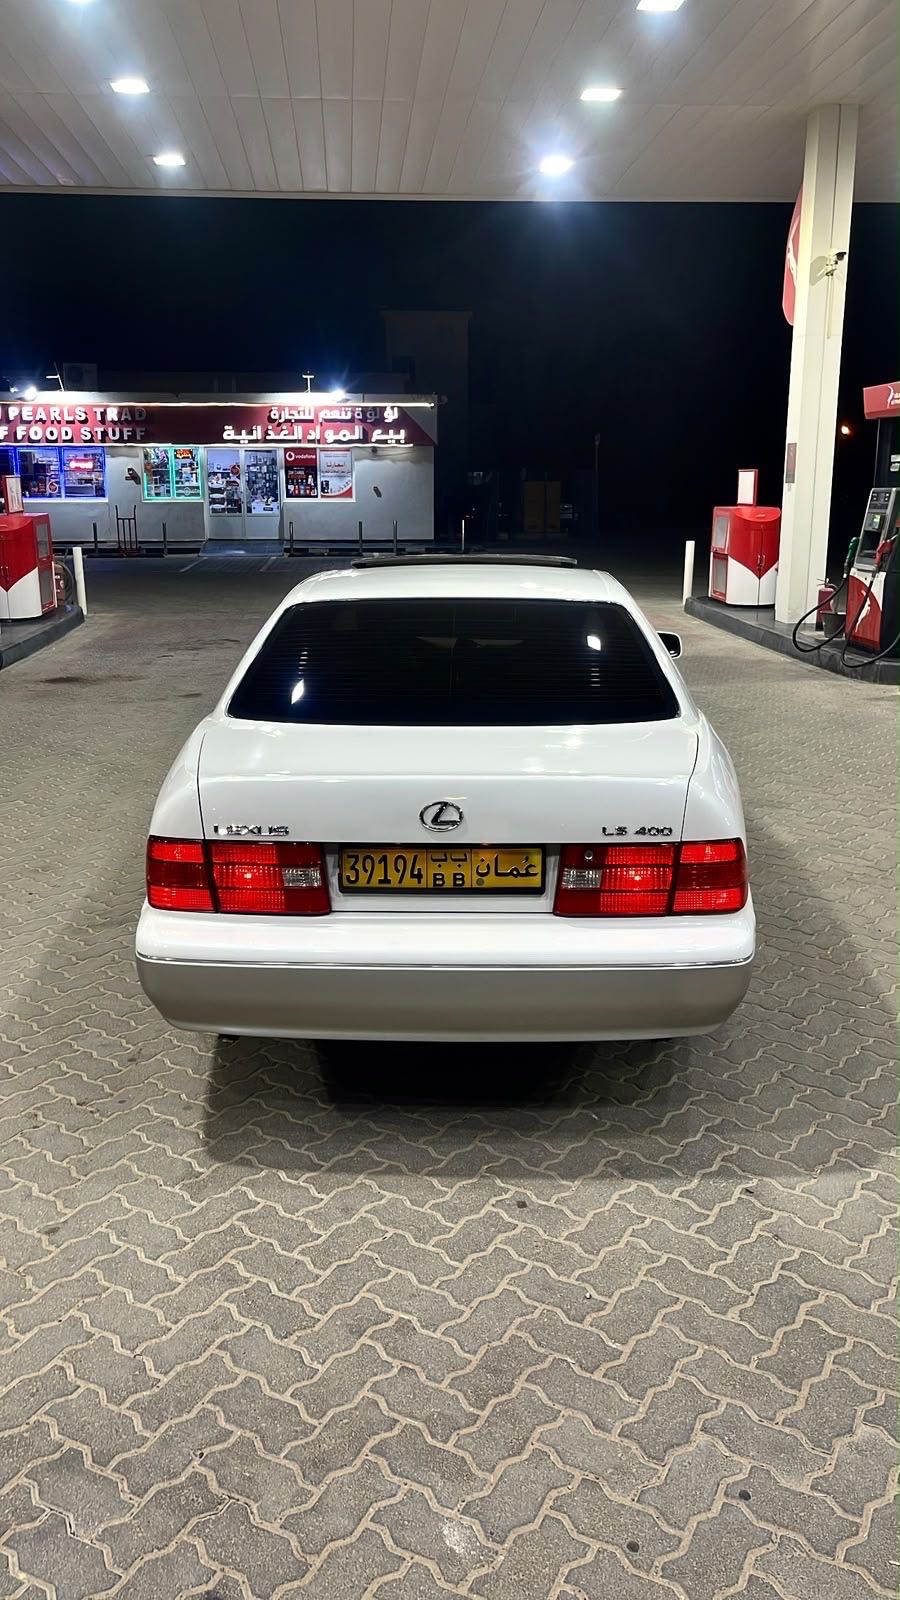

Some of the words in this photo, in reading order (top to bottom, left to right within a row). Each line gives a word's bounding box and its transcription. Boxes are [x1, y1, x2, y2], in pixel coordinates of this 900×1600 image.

[8, 406, 88, 421] PEARLS
[94, 407, 147, 421] TRAD
[270, 406, 315, 423] للتجارة
[0, 427, 9, 440] F
[16, 426, 73, 441] FOOD
[80, 427, 146, 441] STUFF
[222, 425, 303, 444] الغذائية
[306, 425, 364, 443] المواد
[371, 428, 406, 444] بيع
[213, 824, 289, 836] LEXUS
[602, 826, 627, 836] LS
[634, 826, 672, 836] 400
[345, 854, 423, 885] 39194
